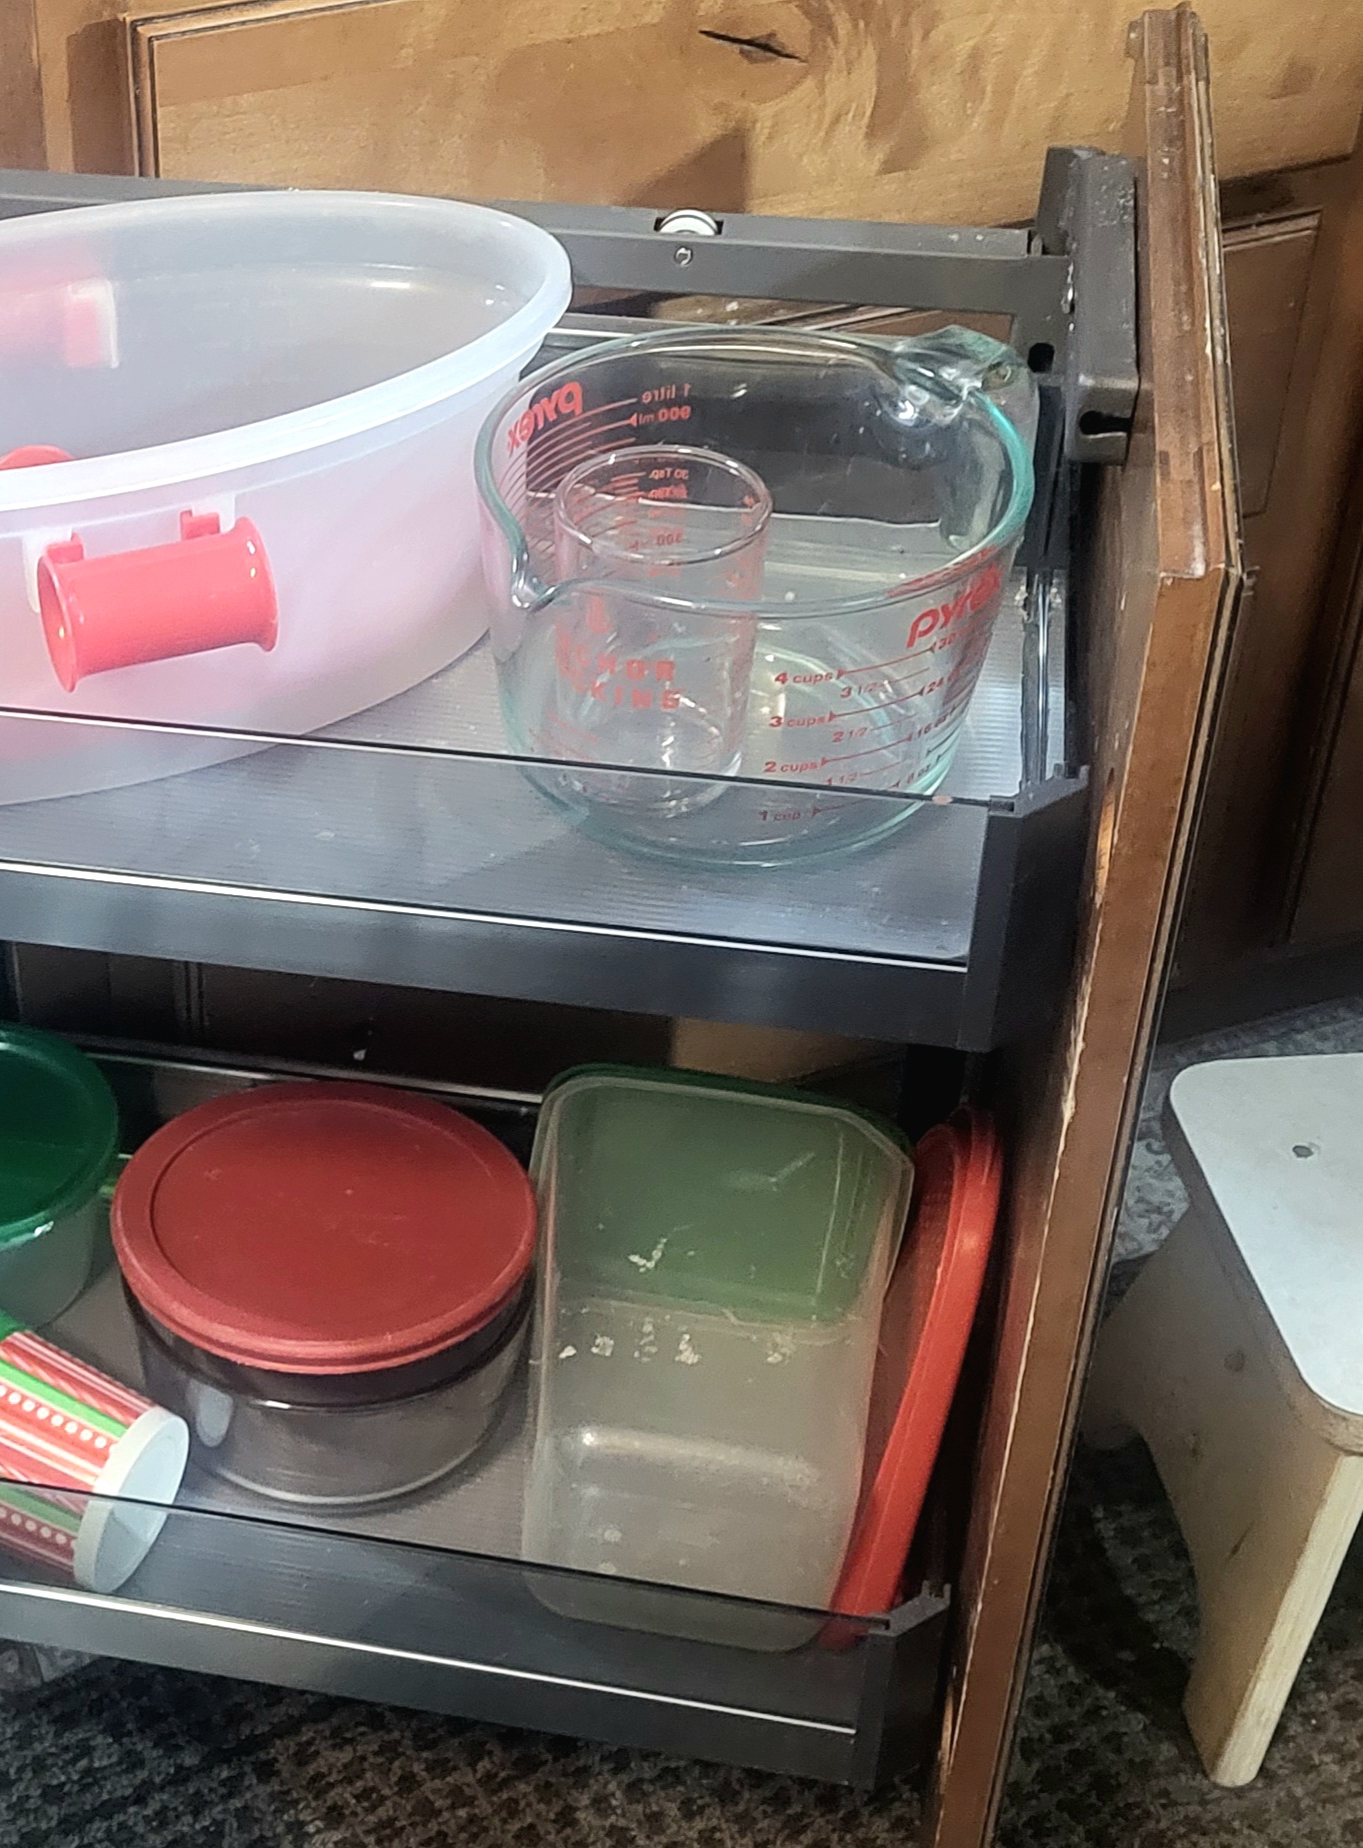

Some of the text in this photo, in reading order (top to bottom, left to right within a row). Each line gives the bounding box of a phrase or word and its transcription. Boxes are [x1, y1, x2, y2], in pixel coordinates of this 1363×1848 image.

[775, 671, 832, 685] 4 cups
[840, 686, 852, 698] 3
[769, 716, 825, 728] 3 cups
[832, 731, 844, 743] 2
[763, 761, 818, 774] 2 cups
[758, 811, 801, 821] 1 cup
